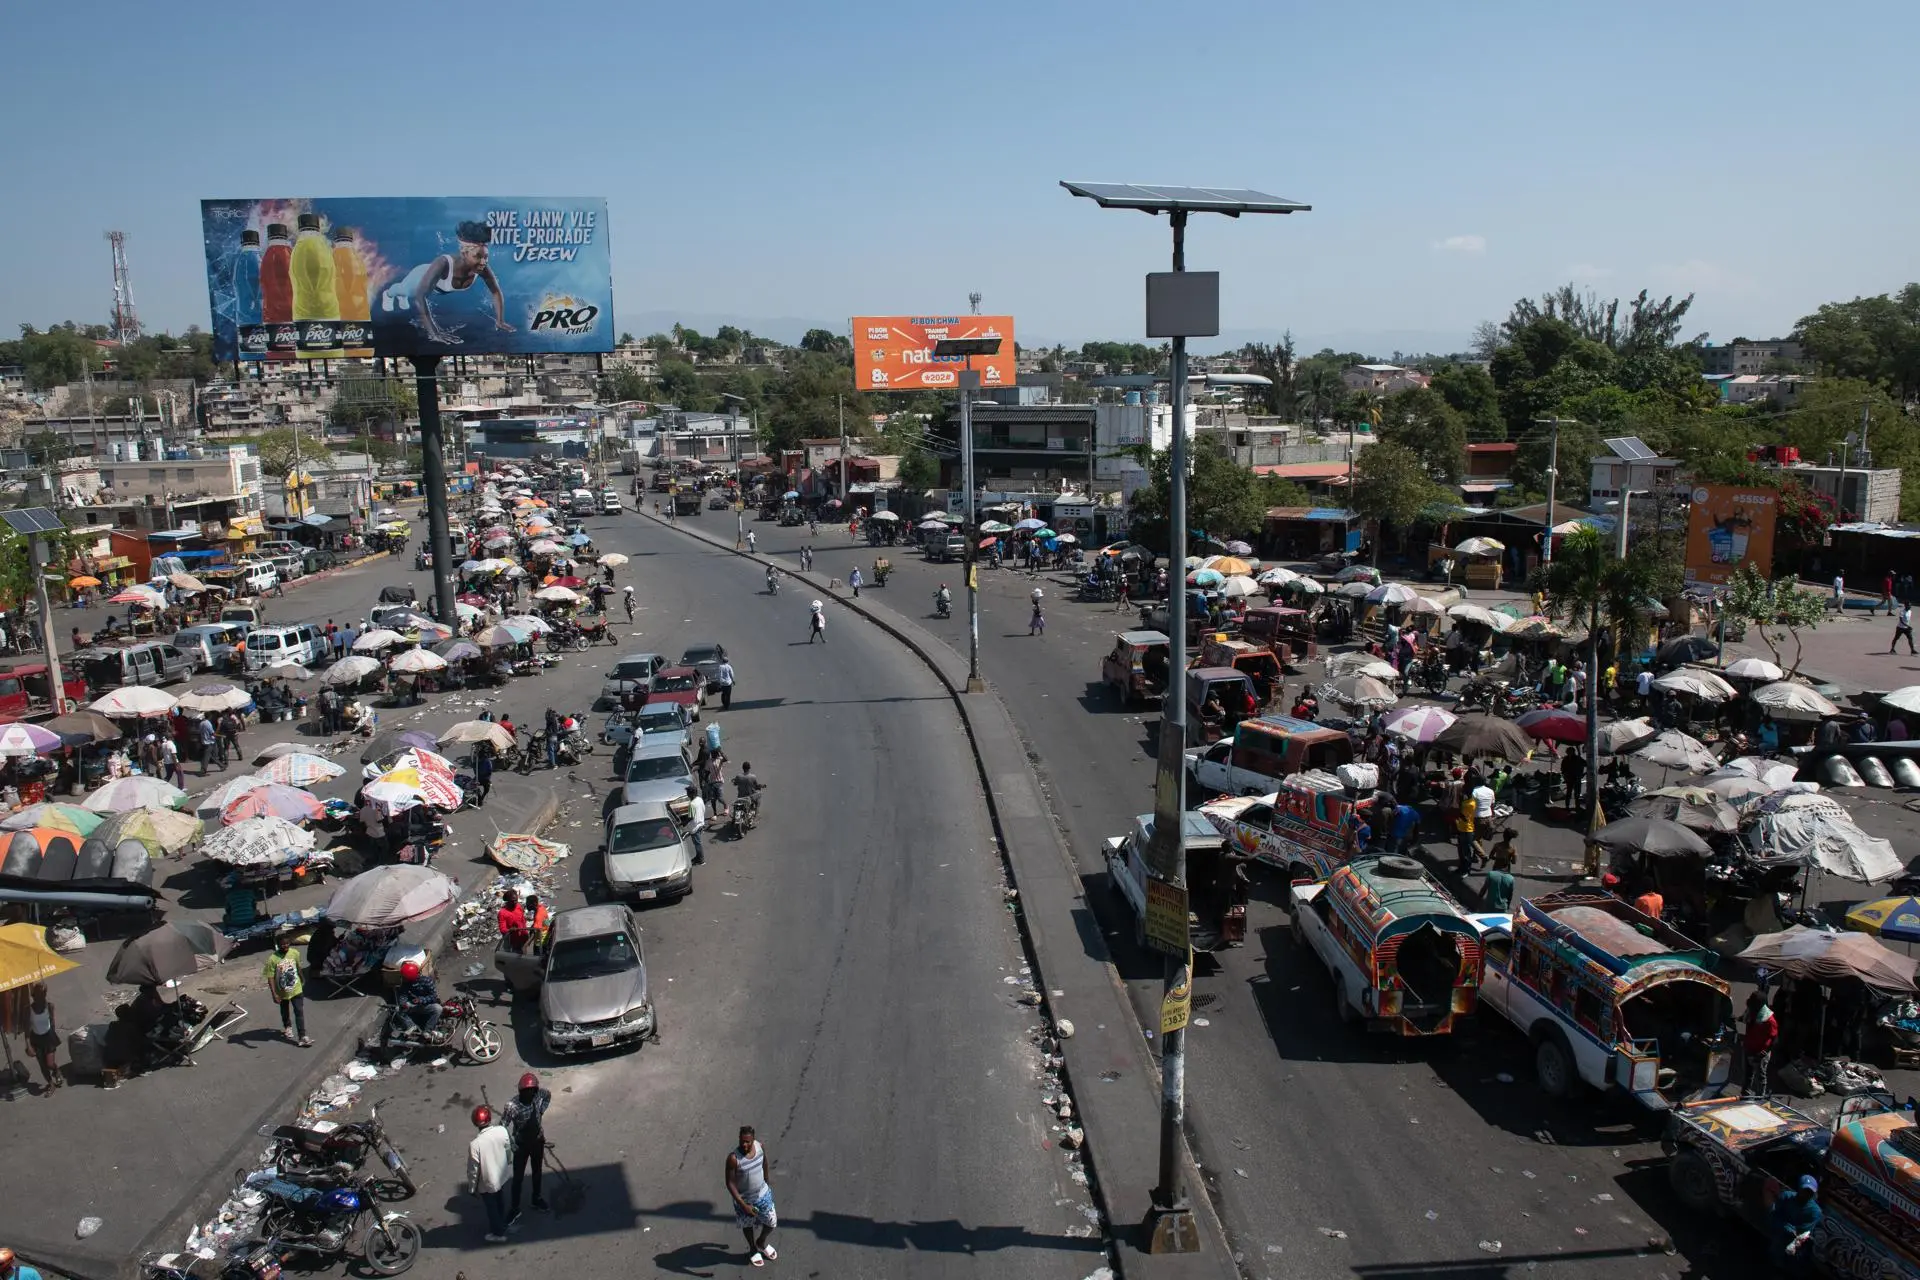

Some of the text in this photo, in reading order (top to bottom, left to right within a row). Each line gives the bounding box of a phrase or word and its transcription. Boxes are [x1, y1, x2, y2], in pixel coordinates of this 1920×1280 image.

[486, 211, 595, 228] SWE JANW VLE
[490, 228, 592, 245] KITE PRORADE
[530, 305, 598, 331] PRO
[305, 328, 333, 341] PRO
[342, 328, 365, 340] PRO
[565, 323, 593, 335] rade
